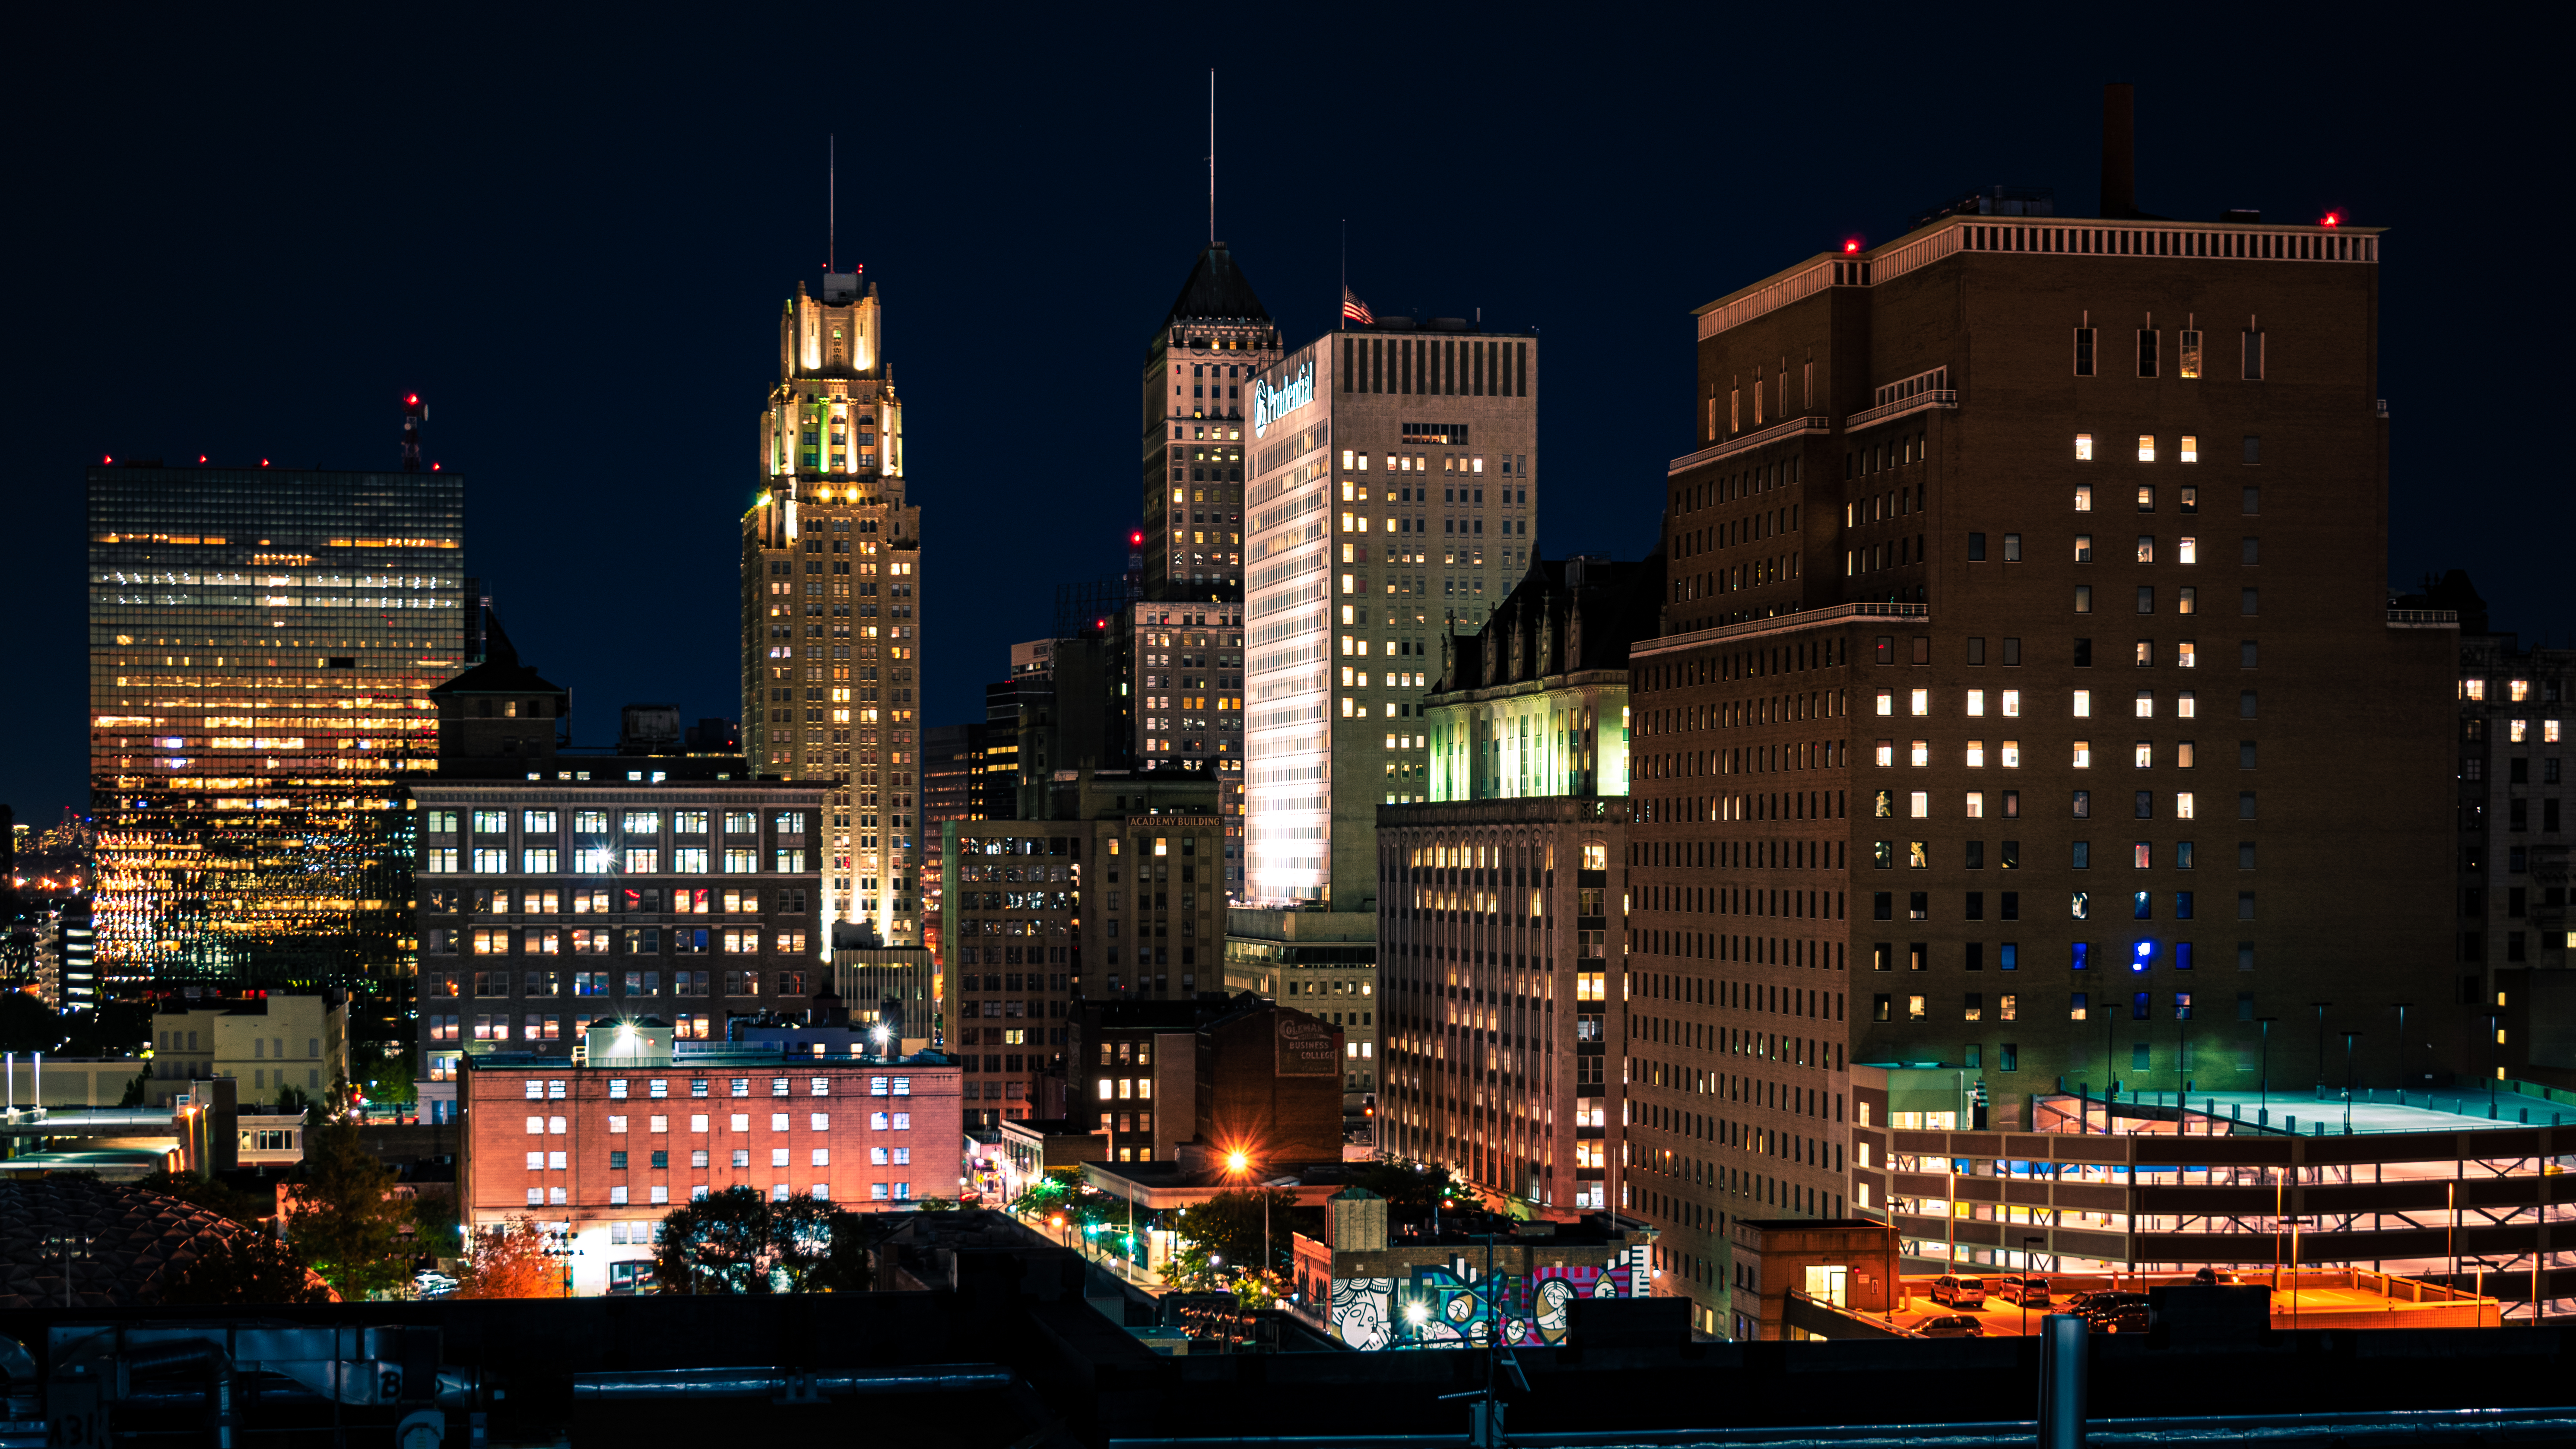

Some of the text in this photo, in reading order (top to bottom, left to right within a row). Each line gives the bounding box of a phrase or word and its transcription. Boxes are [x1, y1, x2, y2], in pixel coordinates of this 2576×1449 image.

[1267, 361, 1313, 424] Prudential
[1130, 817, 1219, 826] ACADEMY BUILDING
[1279, 1020, 1324, 1038] COLEMAN
